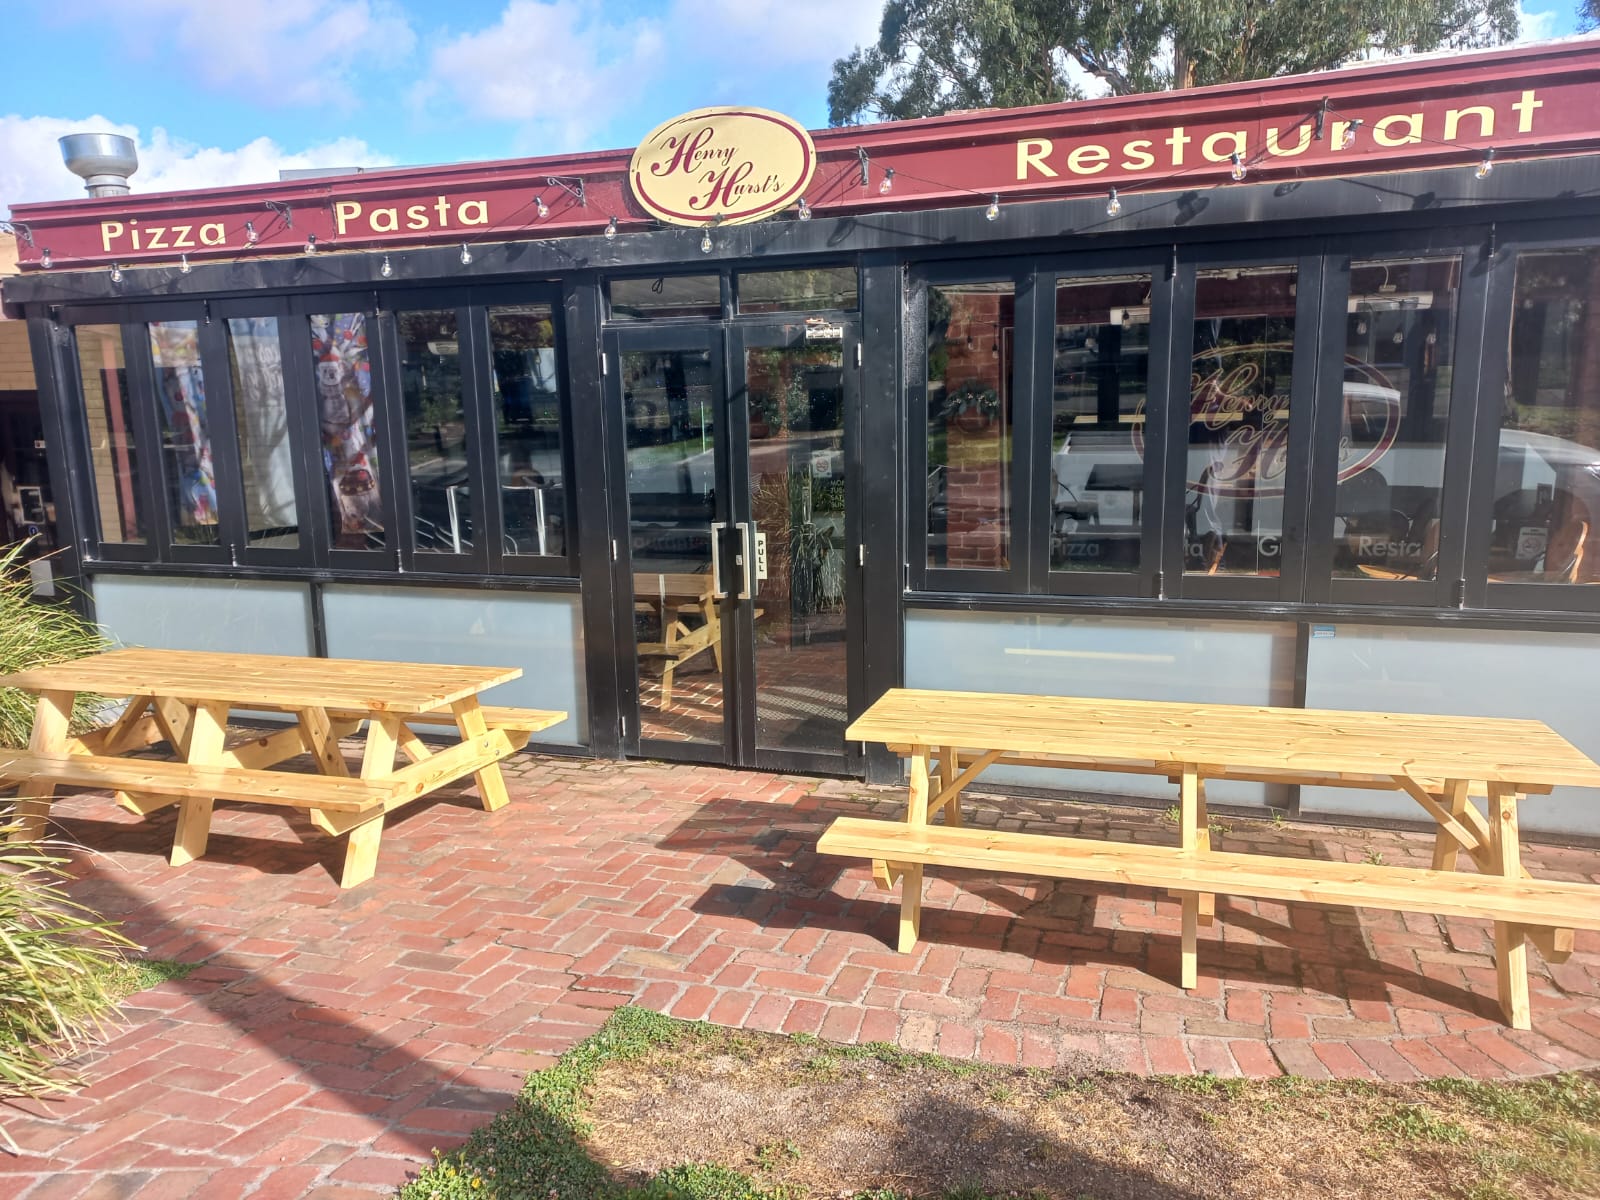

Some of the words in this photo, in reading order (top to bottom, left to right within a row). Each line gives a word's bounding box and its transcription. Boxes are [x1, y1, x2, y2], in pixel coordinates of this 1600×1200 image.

[650, 126, 740, 177] Henry
[1016, 90, 1544, 181] Restaurant
[688, 161, 786, 211] Hurst's
[336, 195, 490, 235] Pasta
[101, 219, 227, 252] Pizza
[757, 539, 765, 572] PULL
[1050, 536, 1100, 557] Pizza
